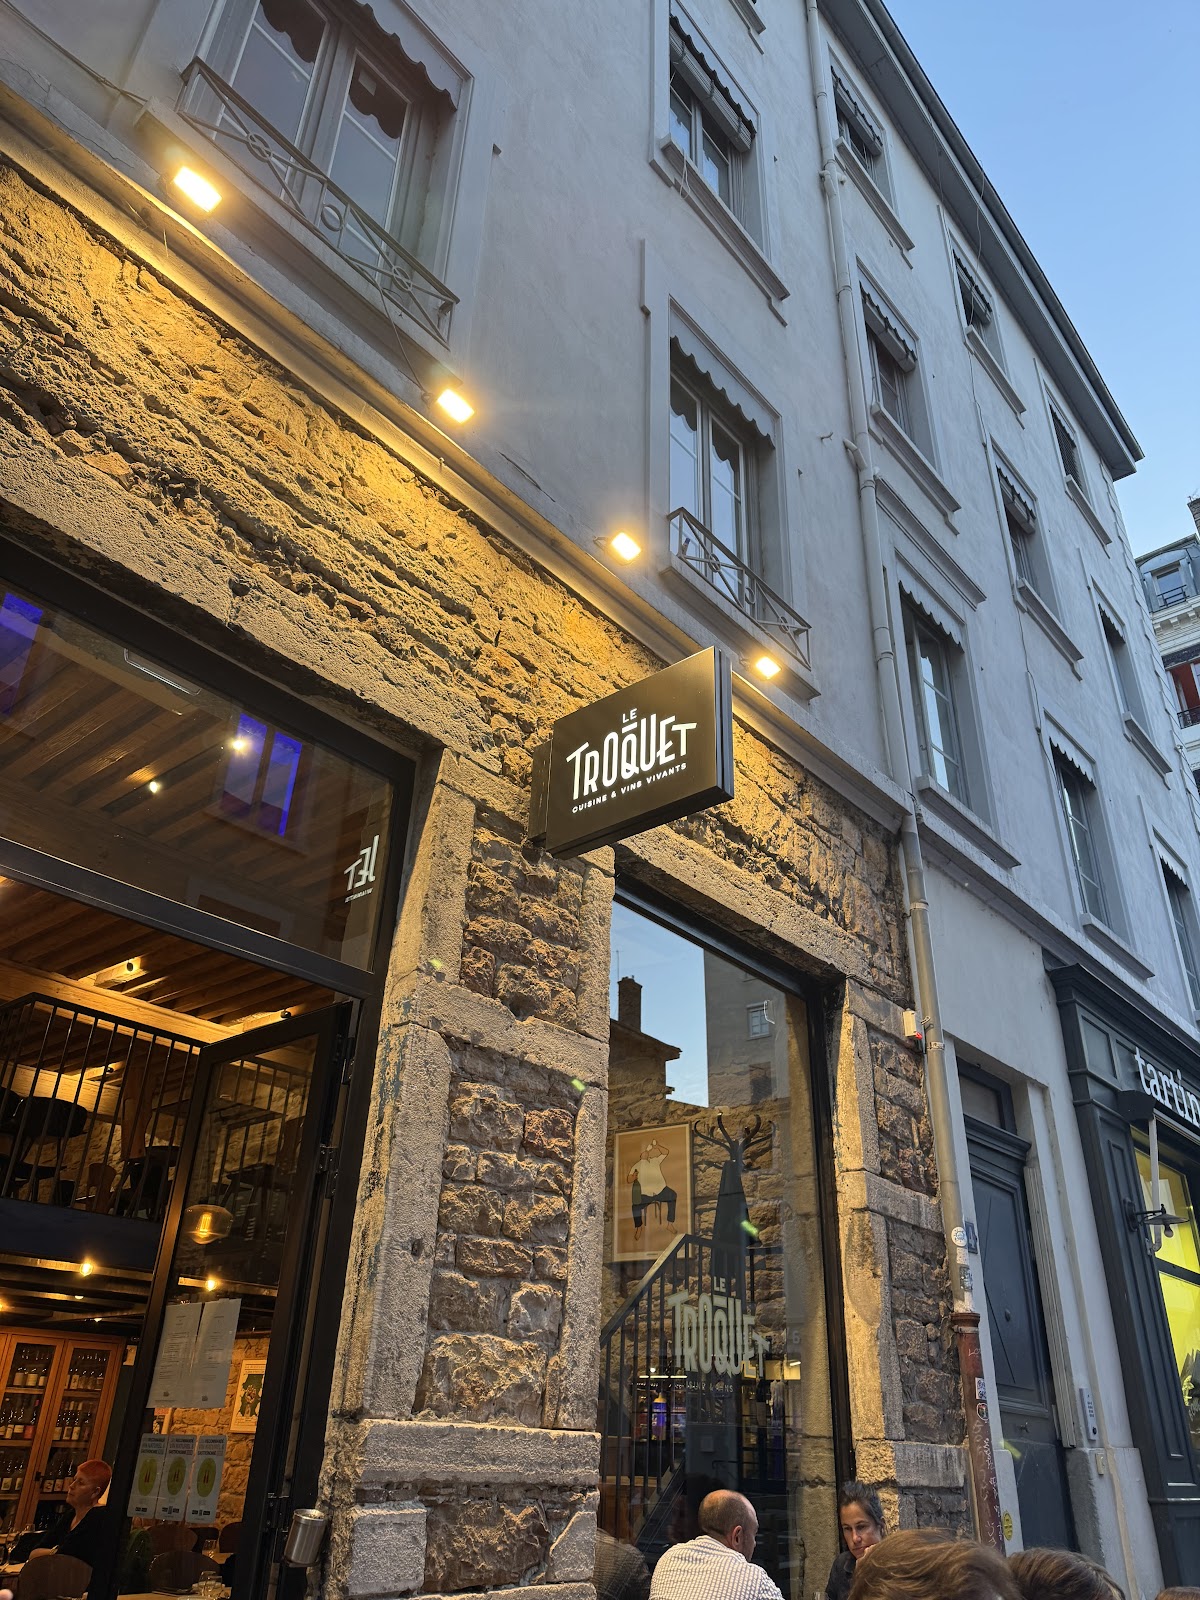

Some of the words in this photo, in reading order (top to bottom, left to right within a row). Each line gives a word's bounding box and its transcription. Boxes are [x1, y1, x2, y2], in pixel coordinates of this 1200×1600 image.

[622, 708, 638, 724] LE
[566, 713, 698, 801] TROQUET
[571, 794, 608, 814] CUISINE
[611, 790, 617, 799] &
[620, 780, 642, 794] VINS
[646, 762, 687, 784] VIVANTS
[713, 1276, 727, 1292] LE
[667, 1289, 771, 1378] TROQUET
